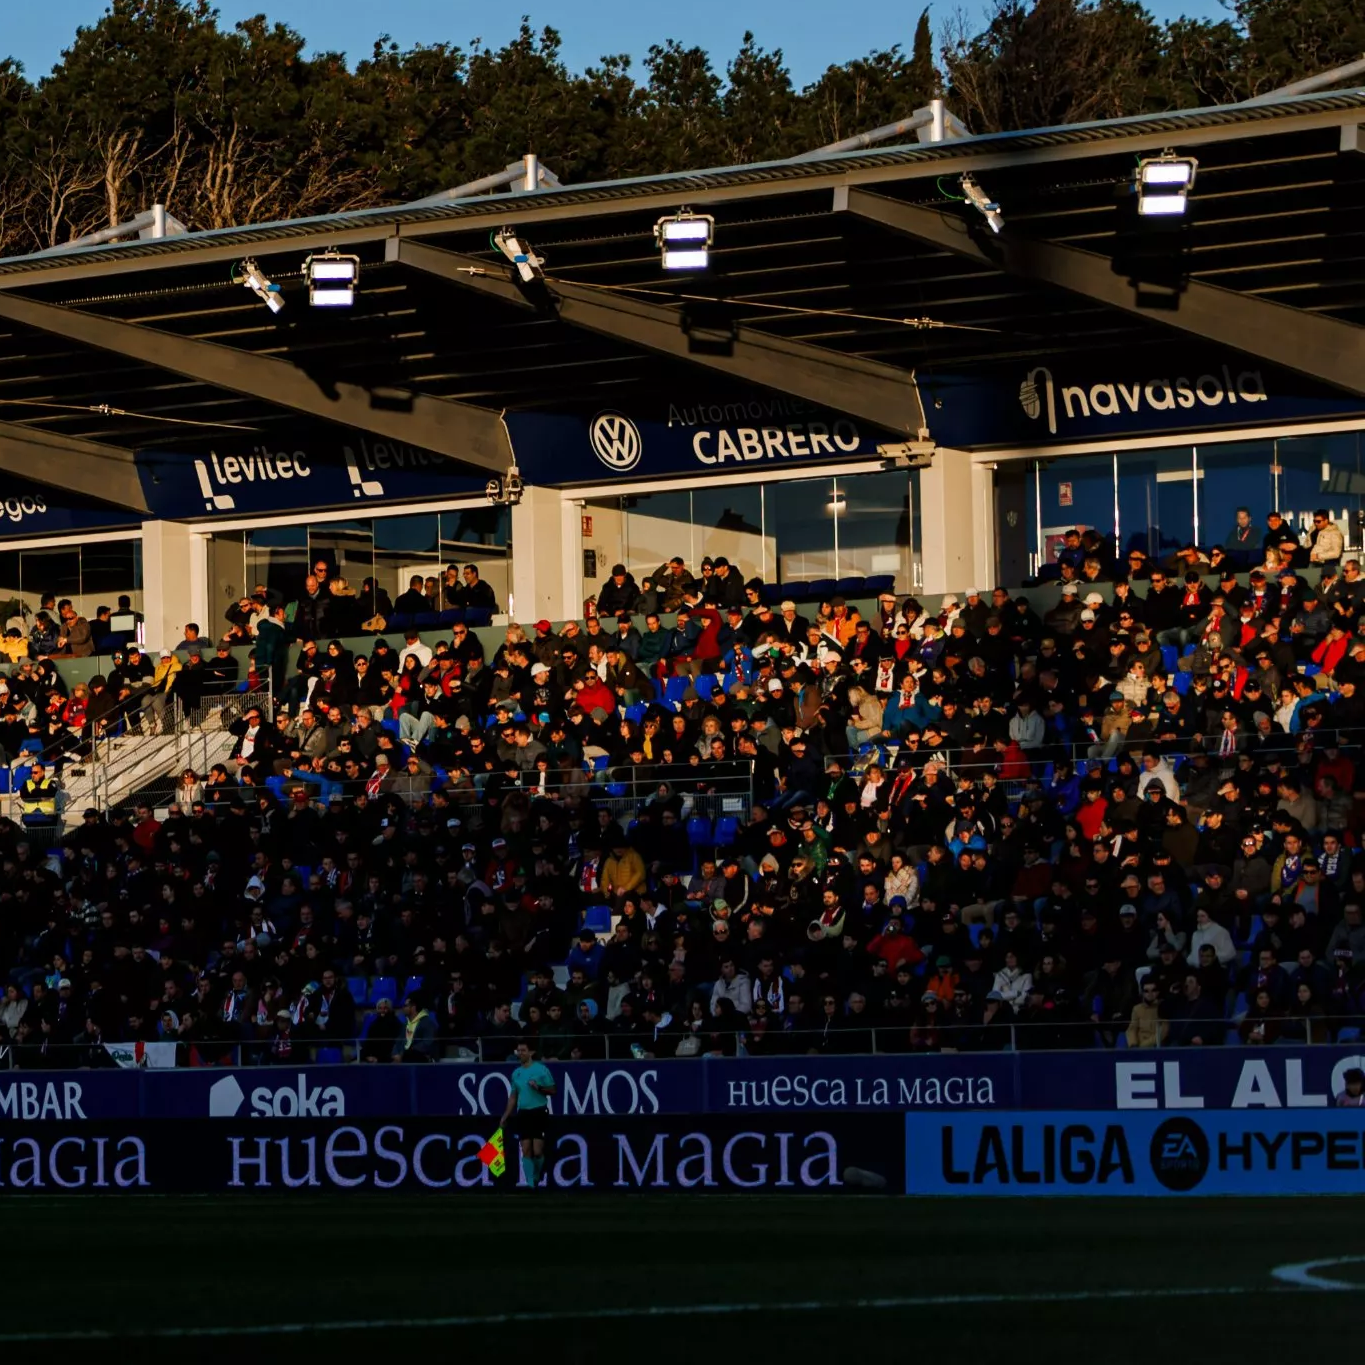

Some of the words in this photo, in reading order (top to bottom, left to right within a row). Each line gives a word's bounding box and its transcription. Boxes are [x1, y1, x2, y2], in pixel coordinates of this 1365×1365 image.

[1061, 364, 1269, 418] navasola
[210, 445, 311, 485] levitec
[692, 419, 860, 465] CABRERO
[250, 1072, 346, 1117] soka
[1115, 1059, 1205, 1110] EL
[942, 1123, 1135, 1185] LALIGA
[1218, 1131, 1365, 1171] HYPE
